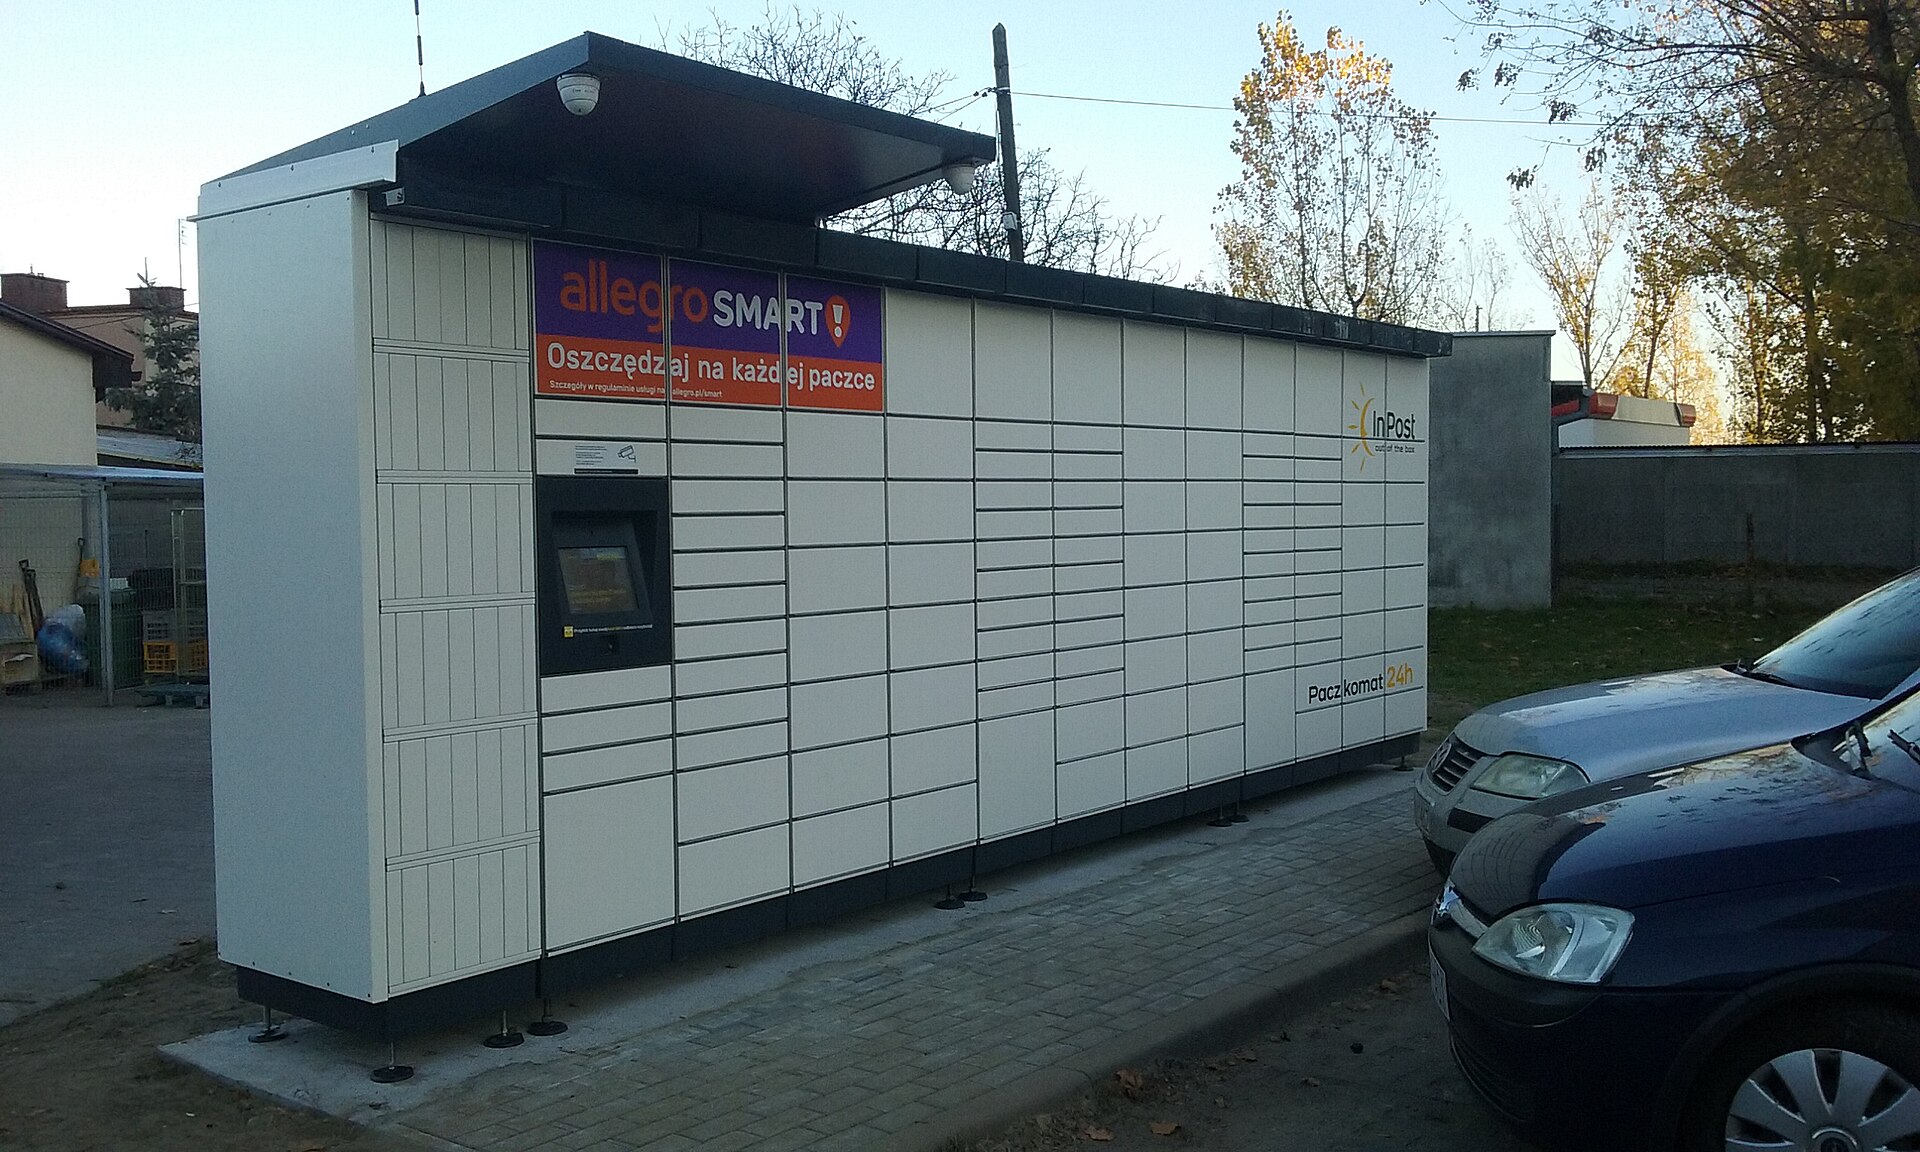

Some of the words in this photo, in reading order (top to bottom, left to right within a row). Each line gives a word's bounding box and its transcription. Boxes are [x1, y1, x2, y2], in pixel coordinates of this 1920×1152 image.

[559, 258, 709, 333] allegro
[547, 342, 690, 383] Oszczędzaj
[698, 360, 725, 380] na
[732, 356, 804, 391] każdej
[809, 368, 876, 391] paczce
[549, 380, 586, 391] Szczegóły
[588, 383, 595, 391] w
[1373, 410, 1415, 440] InPost
[1405, 445, 1415, 453] box
[1308, 673, 1384, 704] Paczkomat
[1387, 662, 1413, 688] 24h
